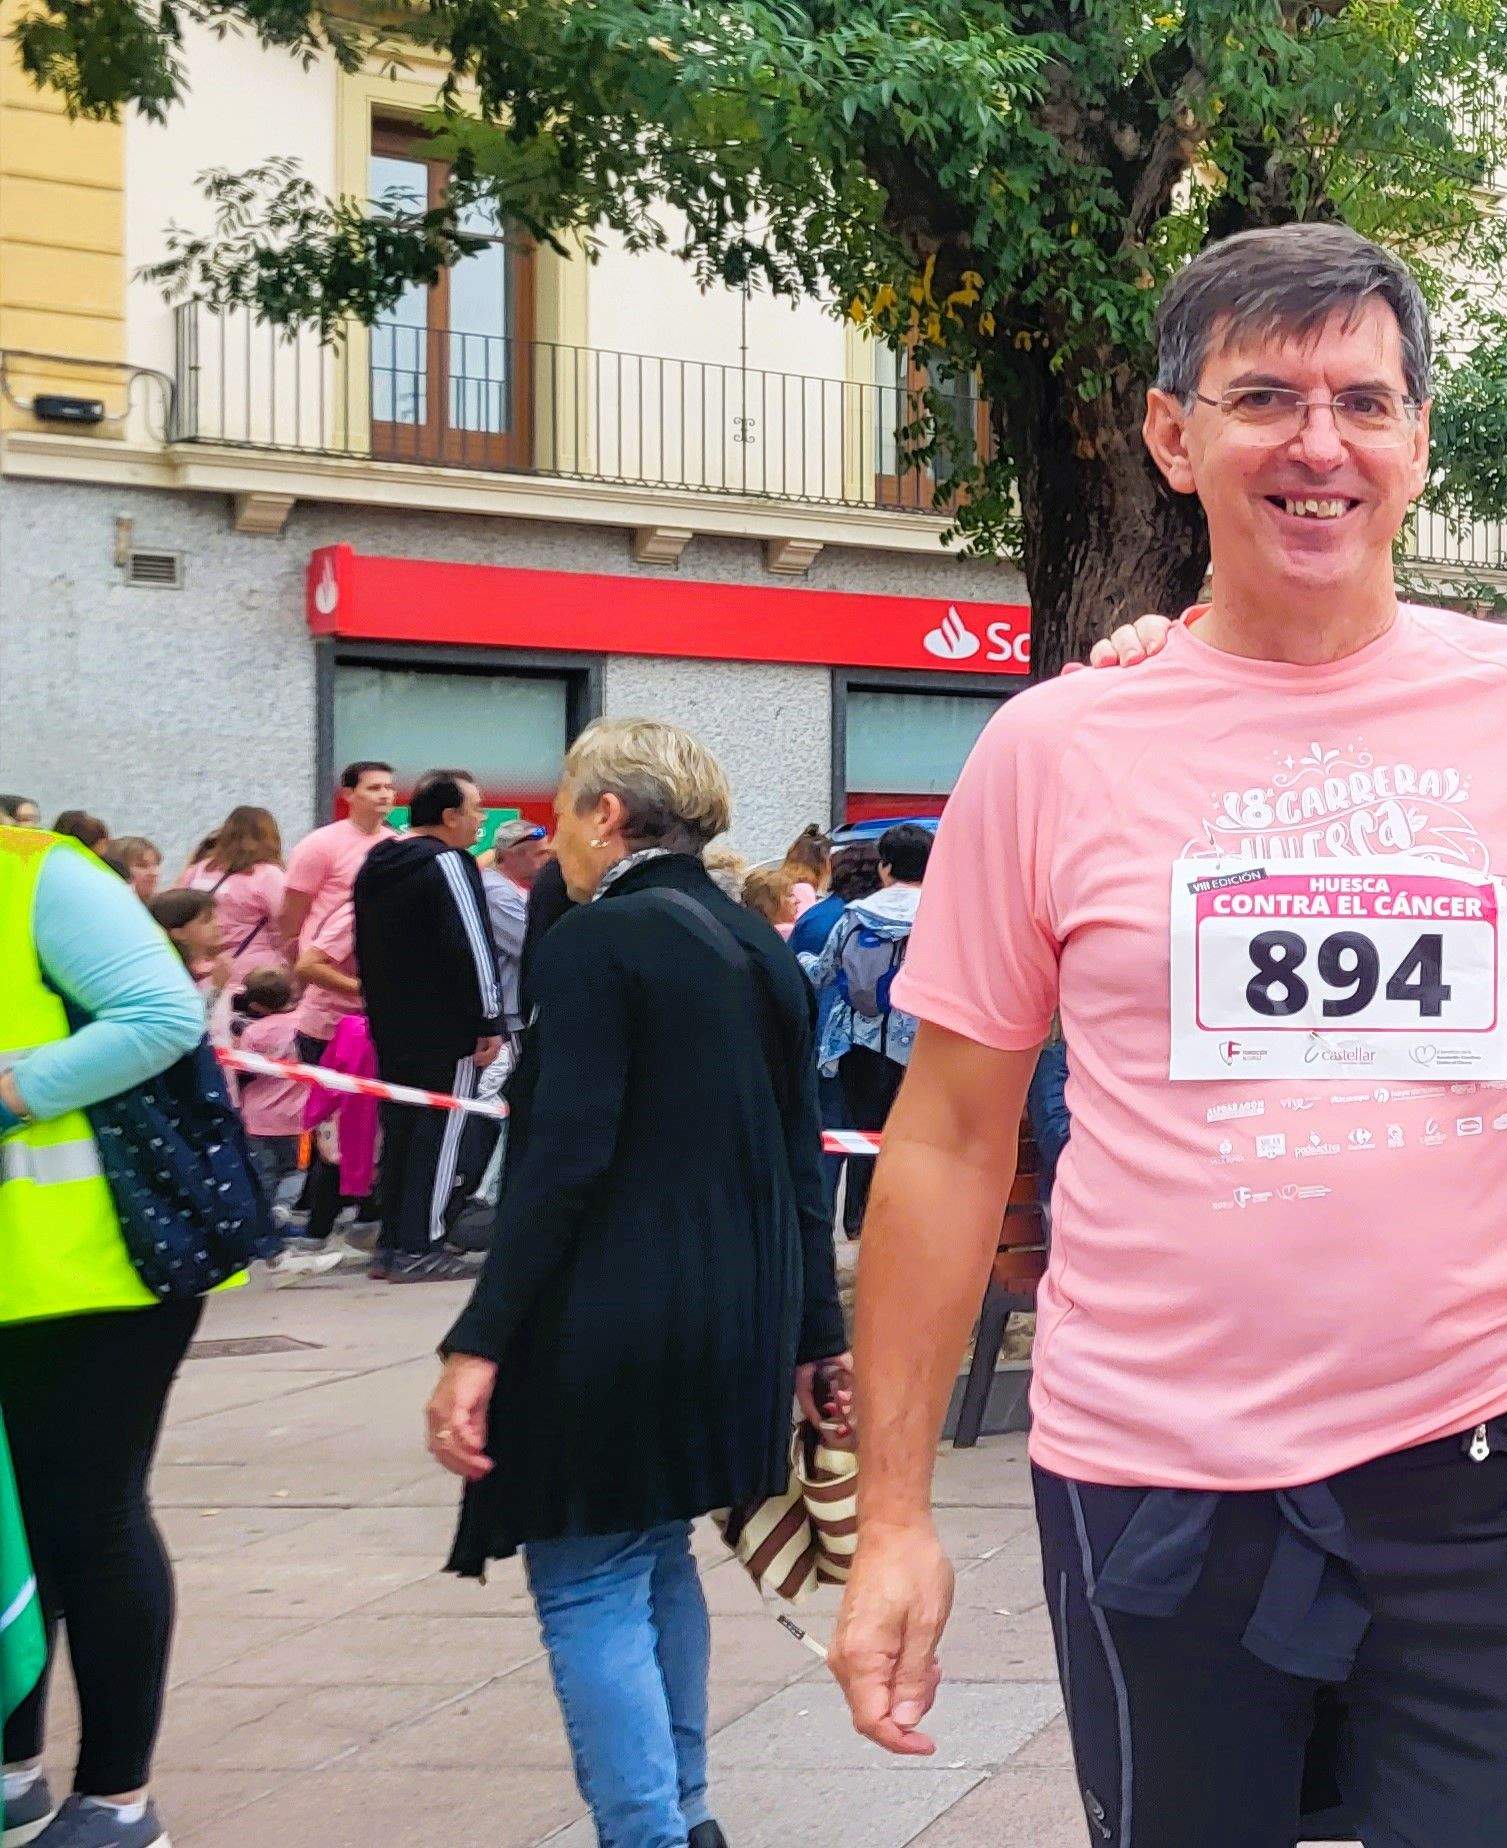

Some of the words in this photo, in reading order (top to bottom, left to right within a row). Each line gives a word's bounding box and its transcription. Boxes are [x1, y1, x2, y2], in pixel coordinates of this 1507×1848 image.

[1309, 877, 1390, 894] HUESCA
[1213, 893, 1331, 916] CONTRA
[1338, 895, 1369, 917] EL
[1374, 890, 1483, 918] CÁNCER
[1245, 929, 1452, 1018] 894
[1321, 1047, 1377, 1062] castellar
